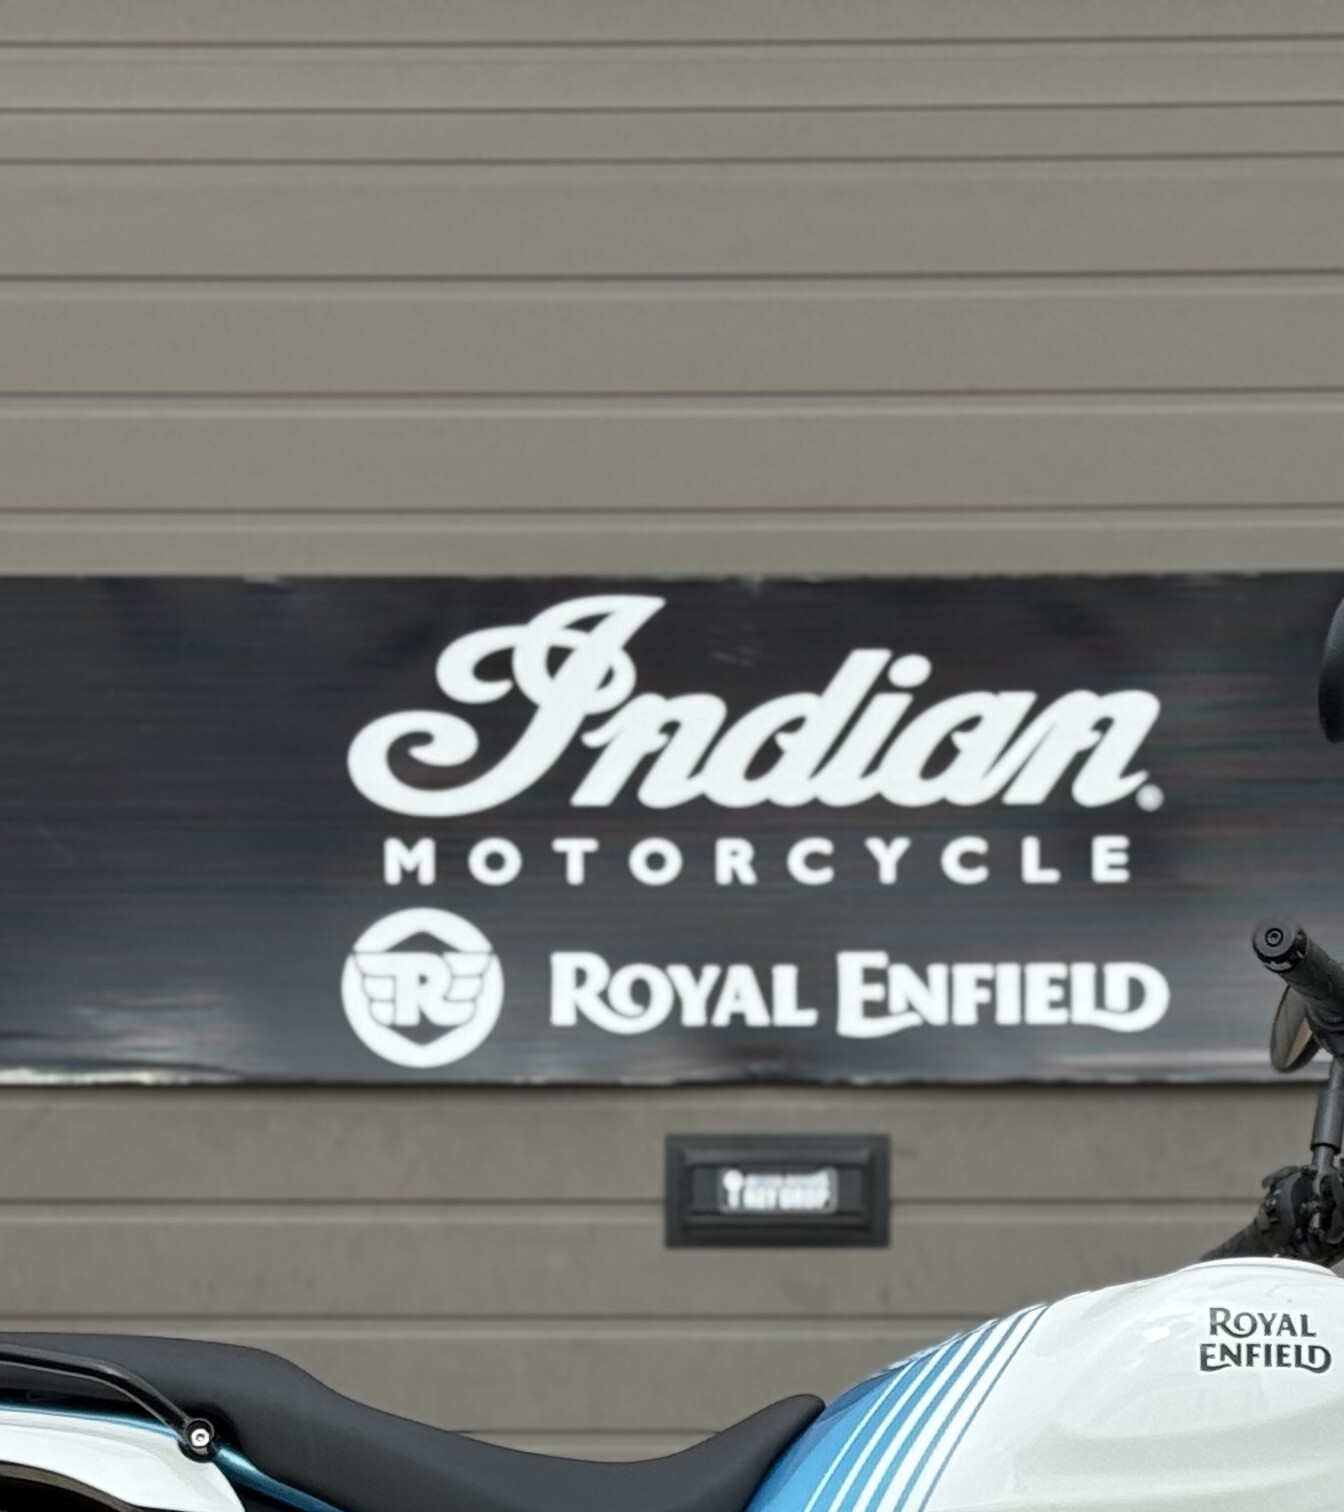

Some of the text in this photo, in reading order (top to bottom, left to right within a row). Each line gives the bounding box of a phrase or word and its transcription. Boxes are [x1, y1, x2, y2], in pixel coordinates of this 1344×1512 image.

[348, 594, 1161, 817] Indian
[384, 836, 1131, 886] MOTORCYCLE
[550, 951, 1171, 1038] ROYAL ENFIELD
[1209, 1307, 1317, 1338] ROYAL
[1200, 1343, 1332, 1373] ENFIELD
